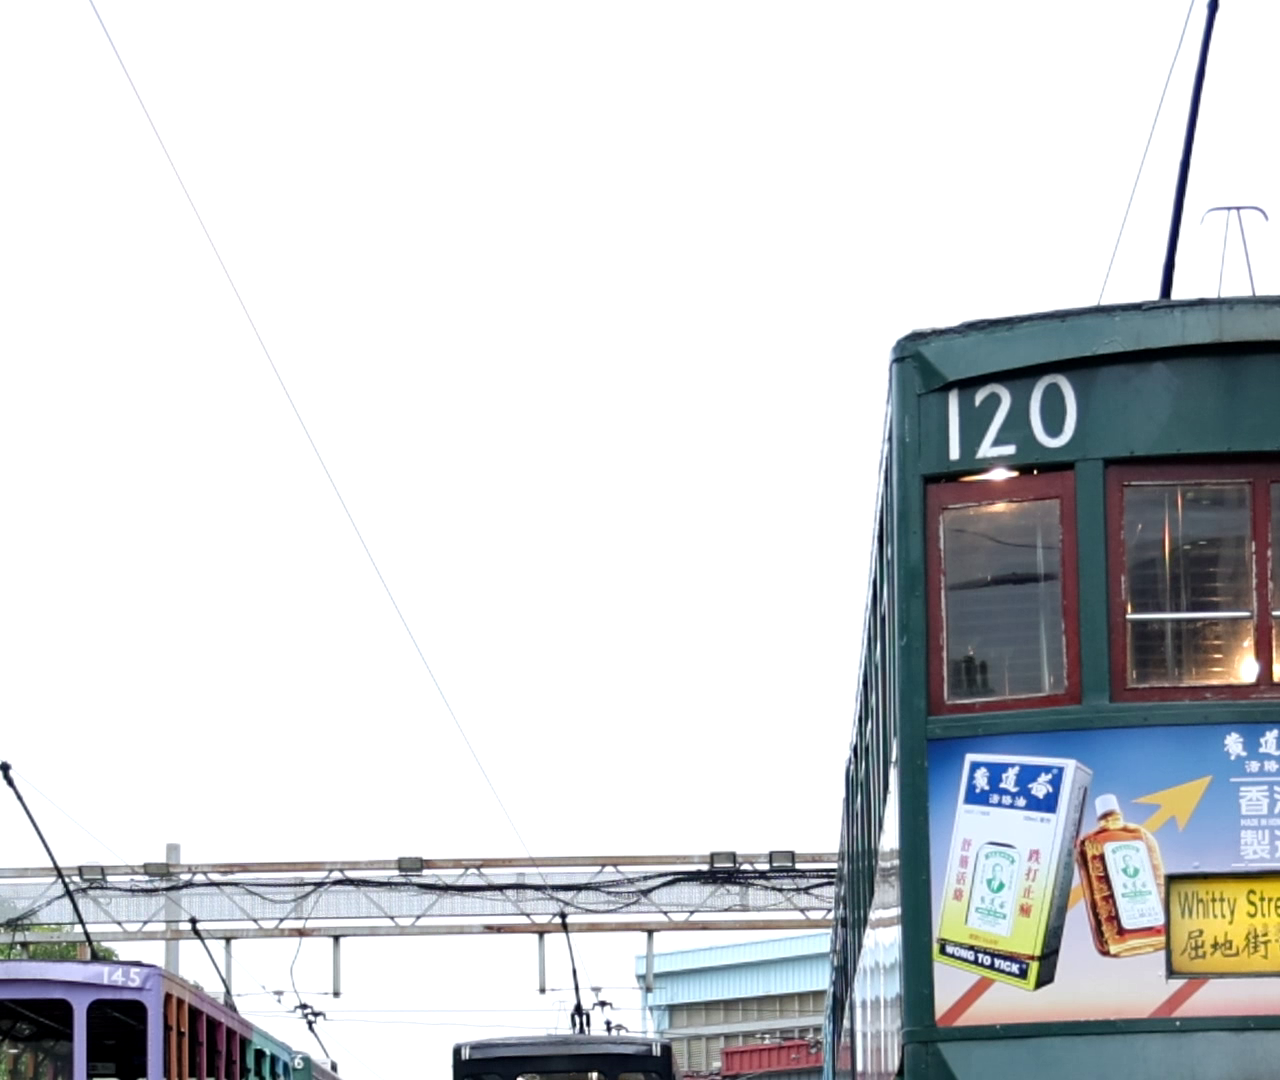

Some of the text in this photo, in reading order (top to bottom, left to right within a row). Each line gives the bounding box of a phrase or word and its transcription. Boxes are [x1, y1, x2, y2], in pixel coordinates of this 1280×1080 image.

[946, 373, 1078, 461] 120
[1178, 890, 1237, 925] Whitty
[944, 944, 1020, 975] WONG TO YICK
[103, 967, 141, 987] 145
